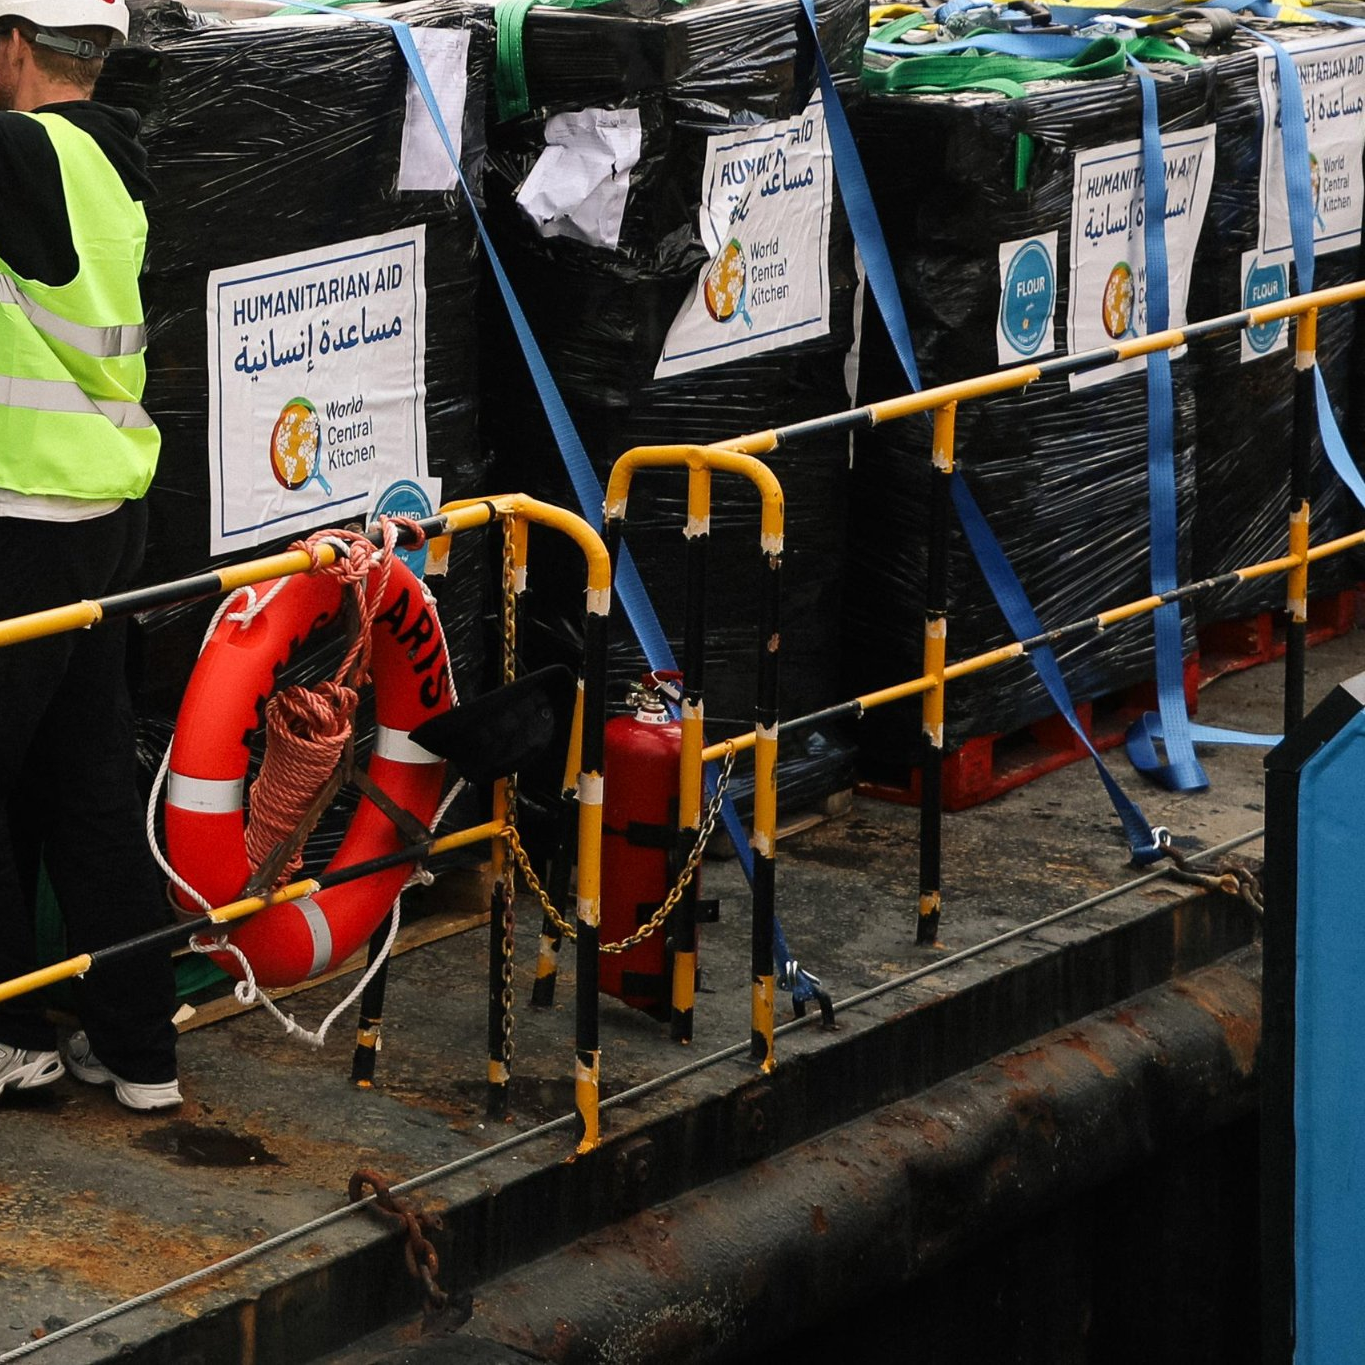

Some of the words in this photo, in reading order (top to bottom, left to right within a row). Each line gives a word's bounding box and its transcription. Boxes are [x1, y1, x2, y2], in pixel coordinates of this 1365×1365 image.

[1347, 55, 1364, 76] AID
[1318, 87, 1364, 120] مساعدة
[791, 119, 814, 146] AID
[1323, 154, 1345, 174] World
[1323, 172, 1350, 193] Central
[1323, 194, 1352, 215] Kitchen
[1084, 199, 1133, 247] إنسانية
[750, 236, 779, 262] World
[751, 258, 787, 284] Central
[233, 271, 370, 327] HUMANITARIAN
[374, 263, 402, 293] AID
[751, 284, 789, 308] Kitchen
[1016, 276, 1045, 298] FLOUR
[1252, 280, 1279, 302] FLOUR
[319, 306, 403, 356] مساعدة
[234, 322, 315, 383] إنسانية
[325, 394, 364, 422] World
[327, 414, 373, 446] Central
[327, 442, 376, 471] Kitchen
